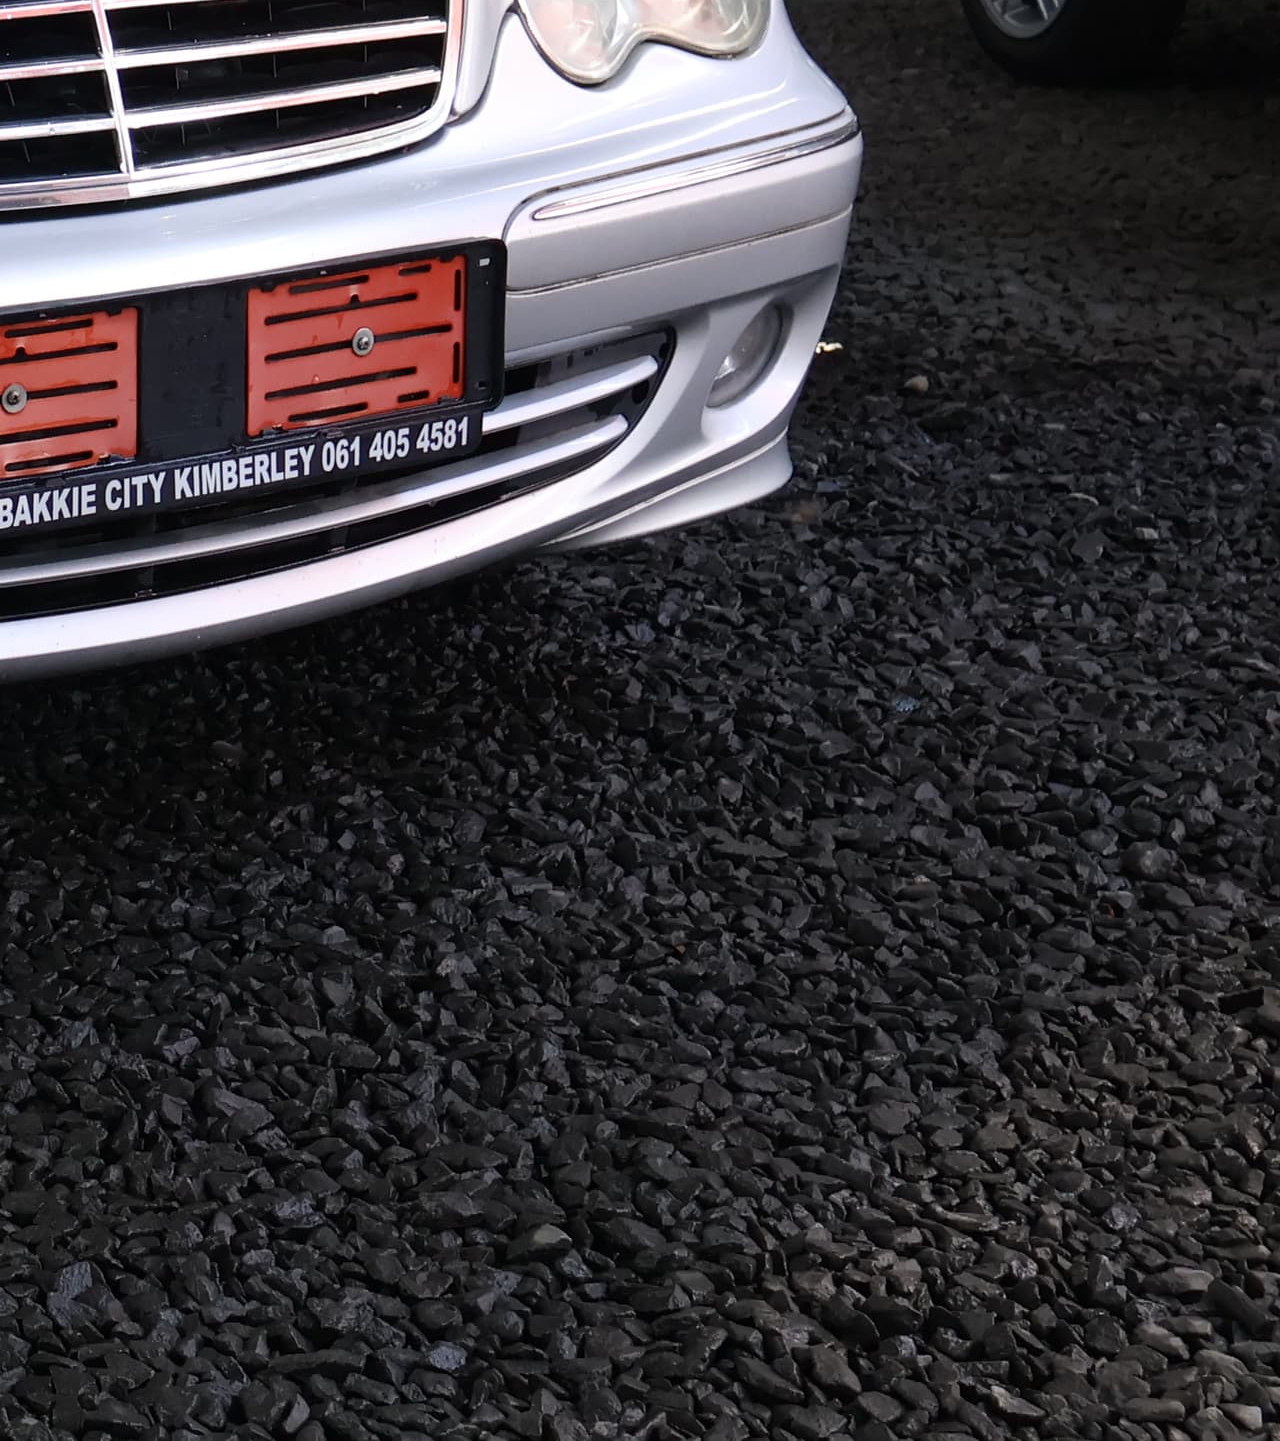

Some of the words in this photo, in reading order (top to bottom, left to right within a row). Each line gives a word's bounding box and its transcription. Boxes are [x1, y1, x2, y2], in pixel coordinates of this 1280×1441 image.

[105, 472, 167, 511] CITY
[174, 444, 316, 499] KIMBERLEY
[322, 436, 361, 472] 061
[368, 427, 410, 463] 405
[416, 416, 469, 454] 4581
